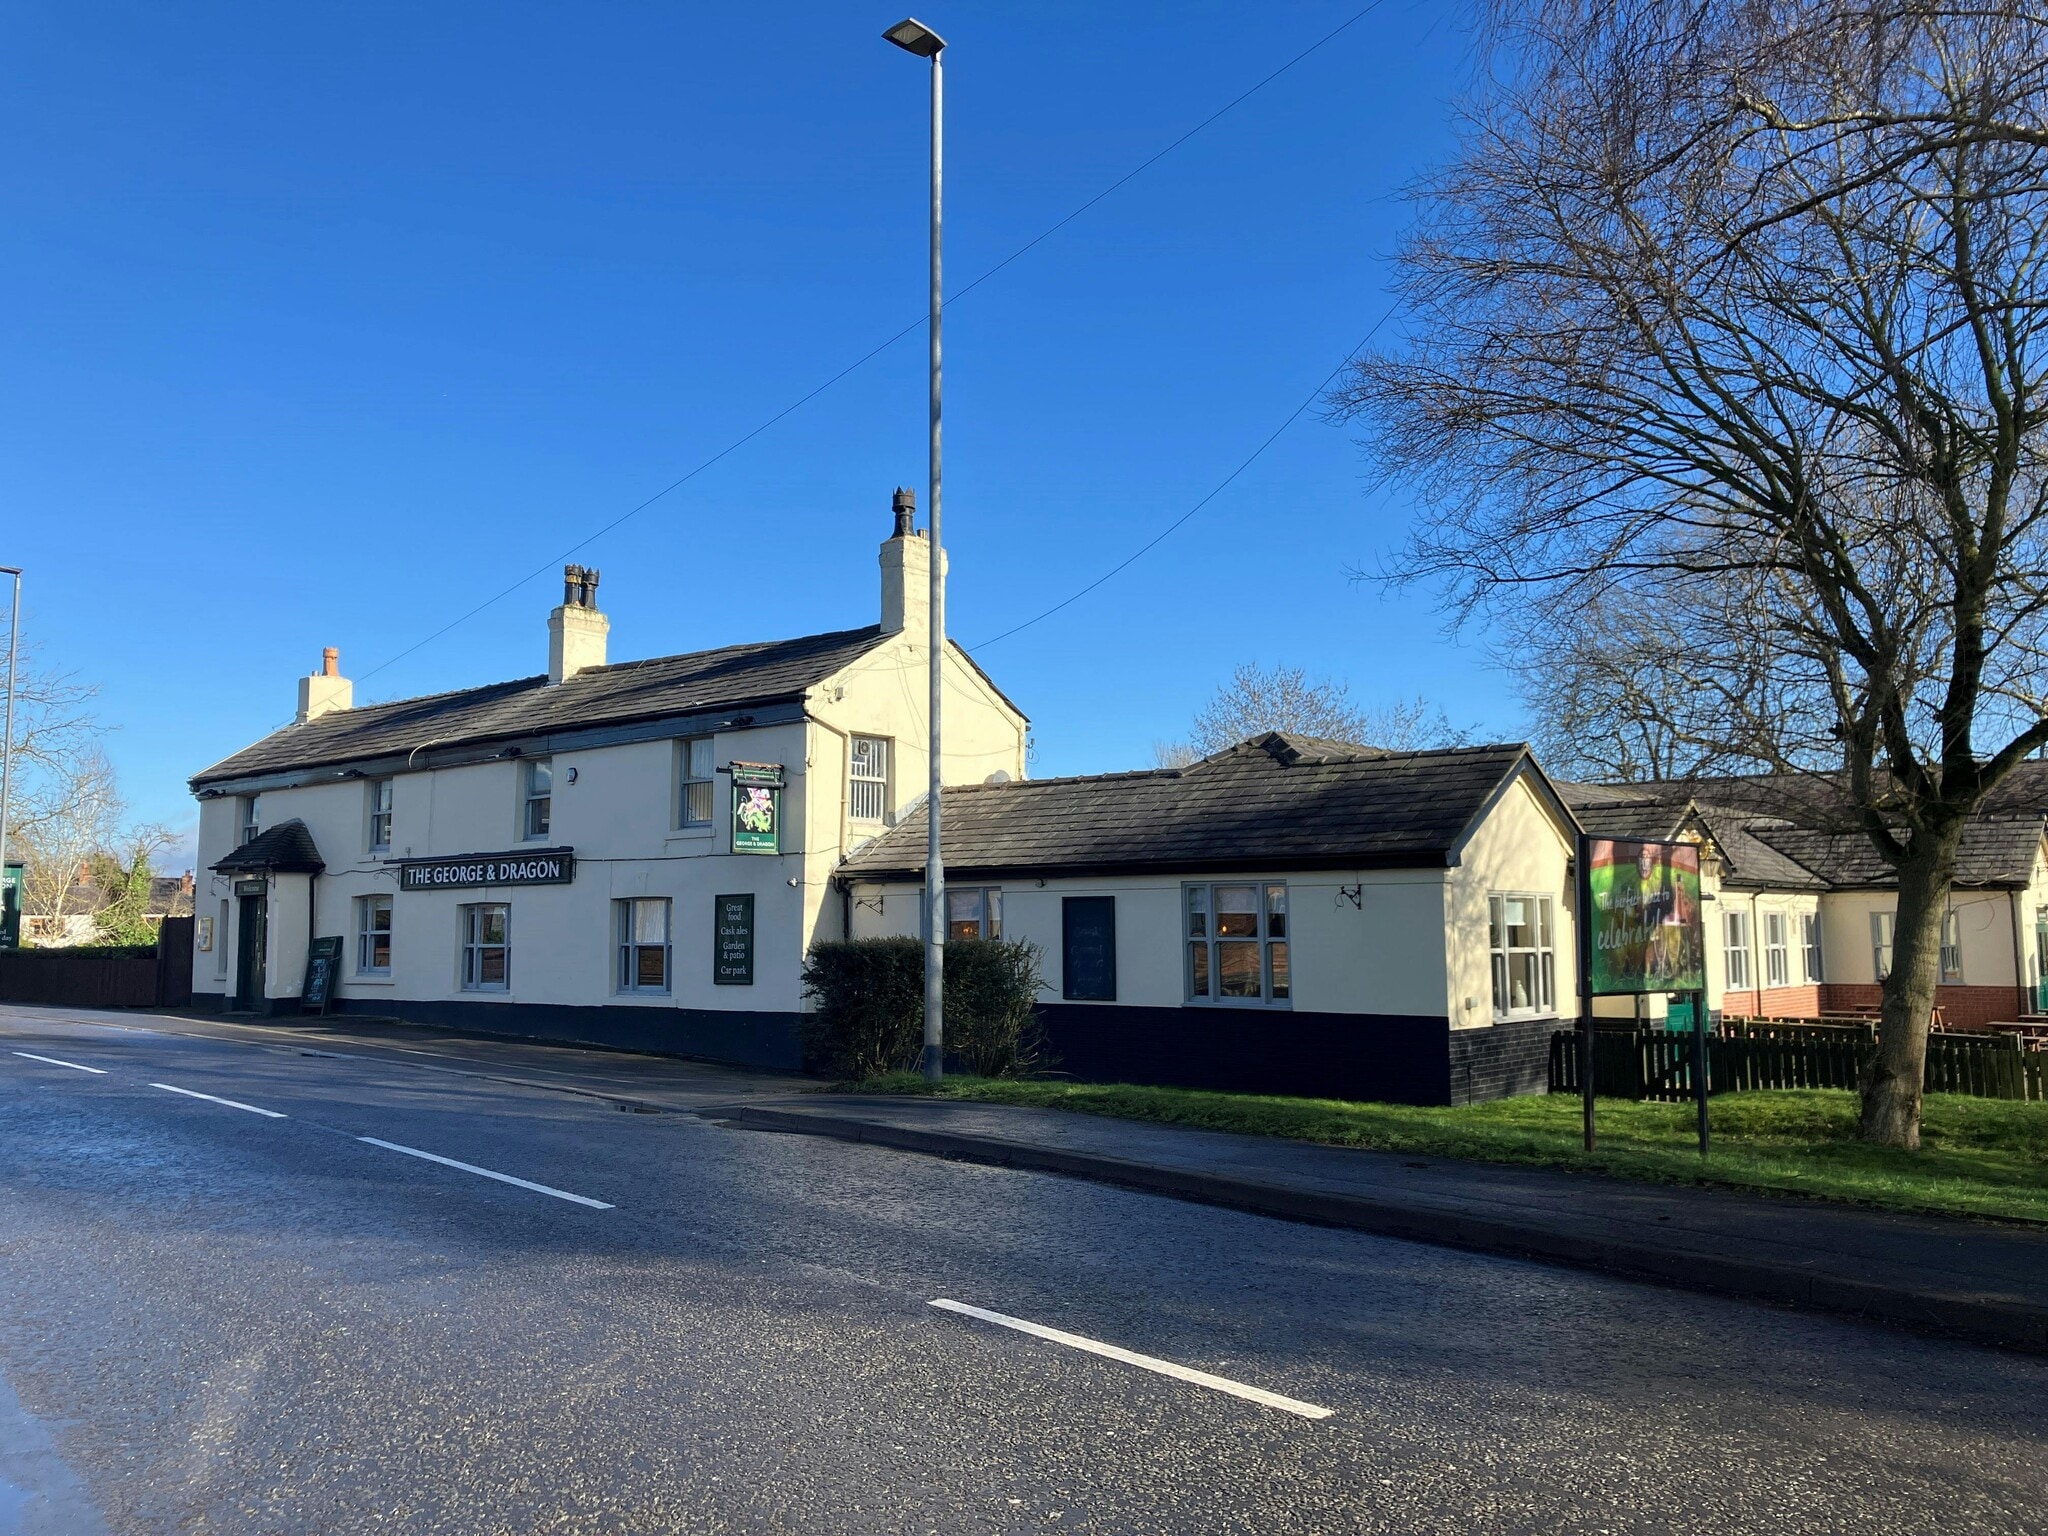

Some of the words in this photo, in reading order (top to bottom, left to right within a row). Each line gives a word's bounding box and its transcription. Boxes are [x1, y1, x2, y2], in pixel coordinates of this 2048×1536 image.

[408, 868, 431, 884] THE
[433, 865, 484, 883] GEORGE
[486, 864, 496, 881] &
[499, 861, 560, 880] DRAGON
[1599, 891, 1614, 911] The
[1614, 886, 1640, 913] perfect
[1661, 885, 1670, 901] to
[726, 903, 743, 912] Great
[727, 911, 741, 921] food
[720, 926, 735, 936] Cask
[736, 925, 748, 935] ales
[723, 940, 745, 950] Garden
[723, 950, 729, 960] &
[729, 949, 745, 961] patio
[720, 965, 732, 975] Car
[732, 964, 746, 976] park
